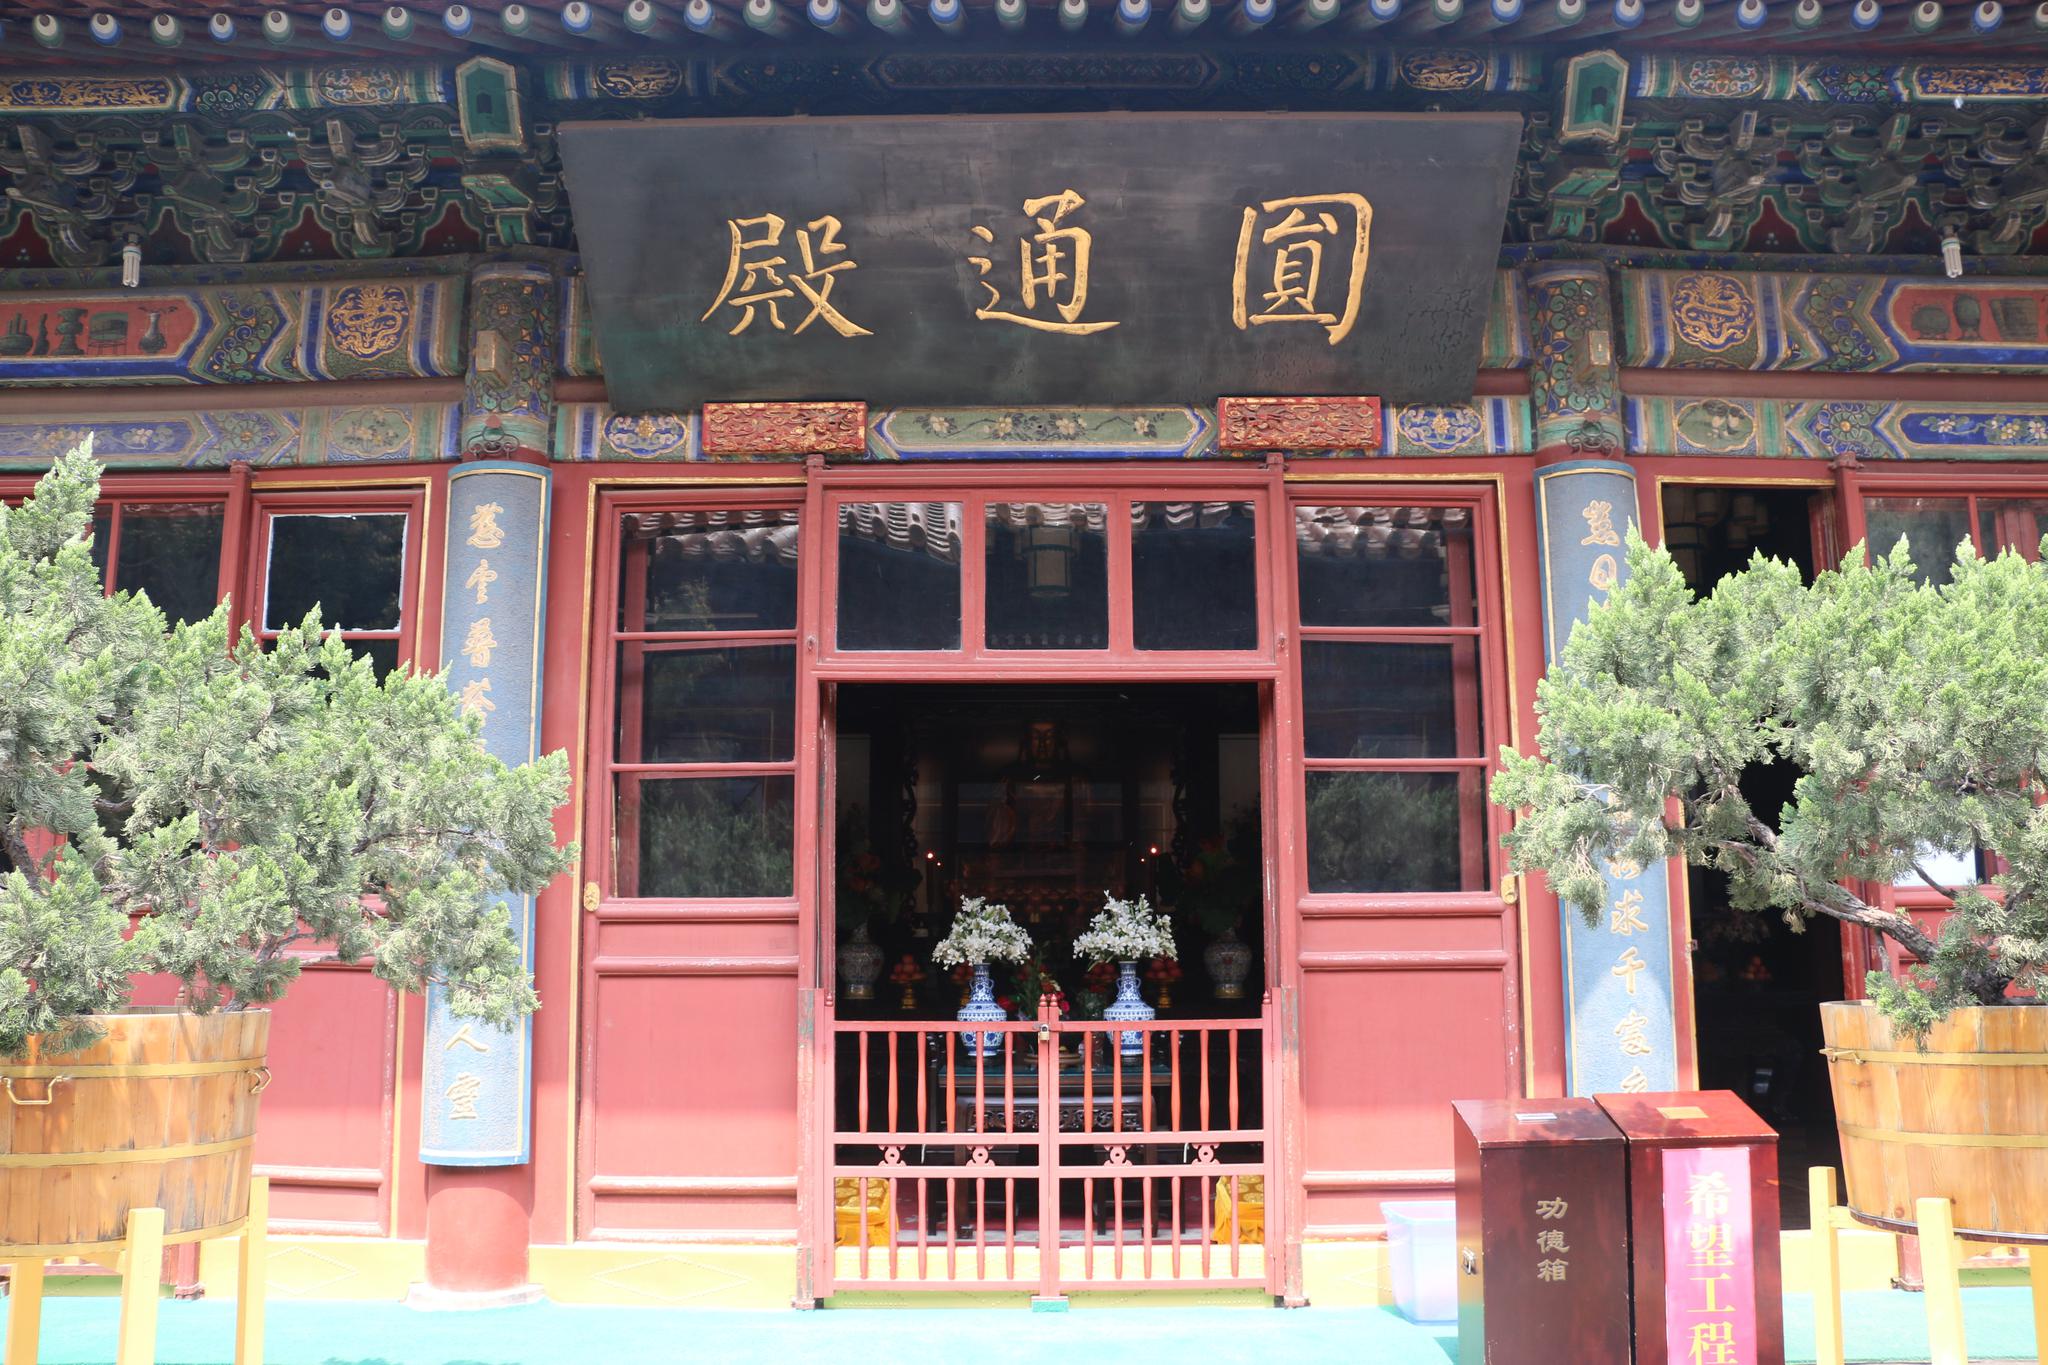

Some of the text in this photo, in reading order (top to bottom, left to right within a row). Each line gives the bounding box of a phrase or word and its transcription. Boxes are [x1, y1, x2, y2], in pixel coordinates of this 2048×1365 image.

[1535, 1197, 1569, 1282] 功德箱
[1685, 1171, 1738, 1365] 希望工程
